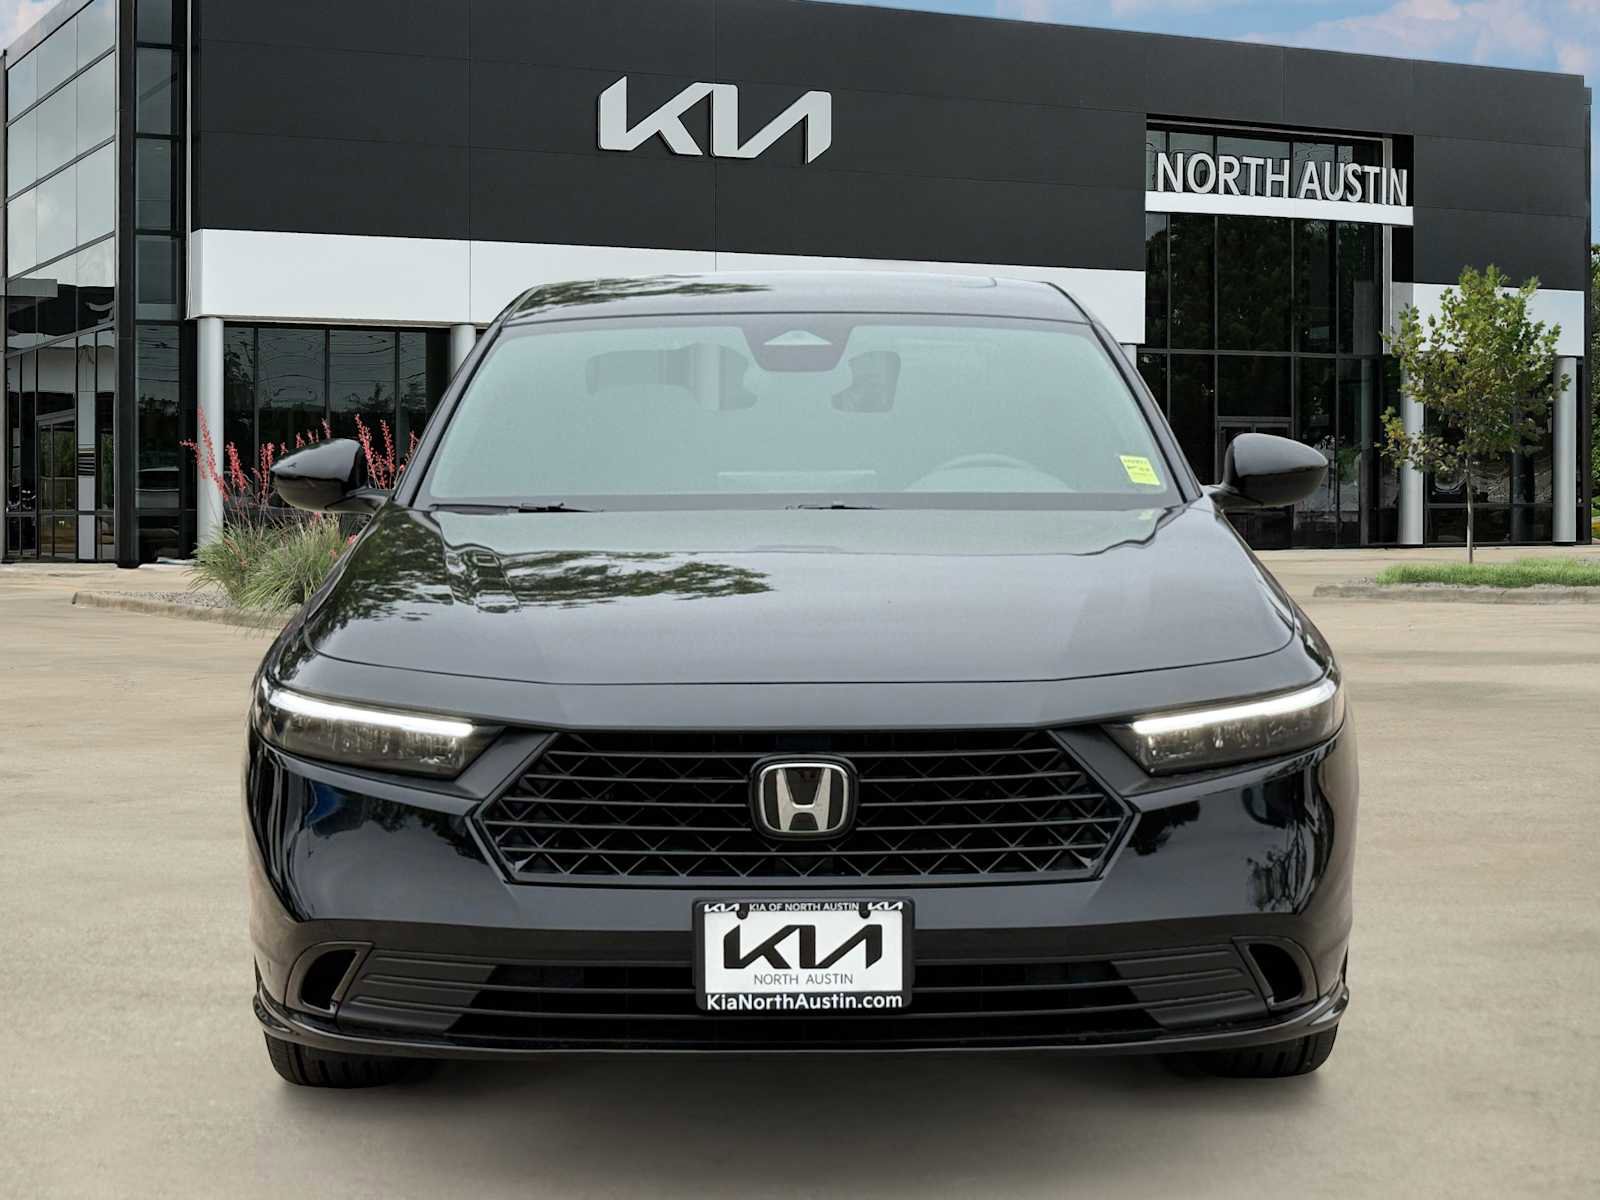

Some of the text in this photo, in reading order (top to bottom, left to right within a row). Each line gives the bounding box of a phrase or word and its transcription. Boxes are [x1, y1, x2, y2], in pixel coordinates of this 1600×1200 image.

[597, 75, 832, 164] KIA
[1157, 151, 1408, 207] NORTH AUSTIN
[749, 902, 859, 912] KIA OF NORTH AUSTIN
[723, 924, 883, 969] KIA
[753, 973, 854, 985] NORTH AUSTIN
[706, 993, 903, 1011] KiaNorthAustin.com
